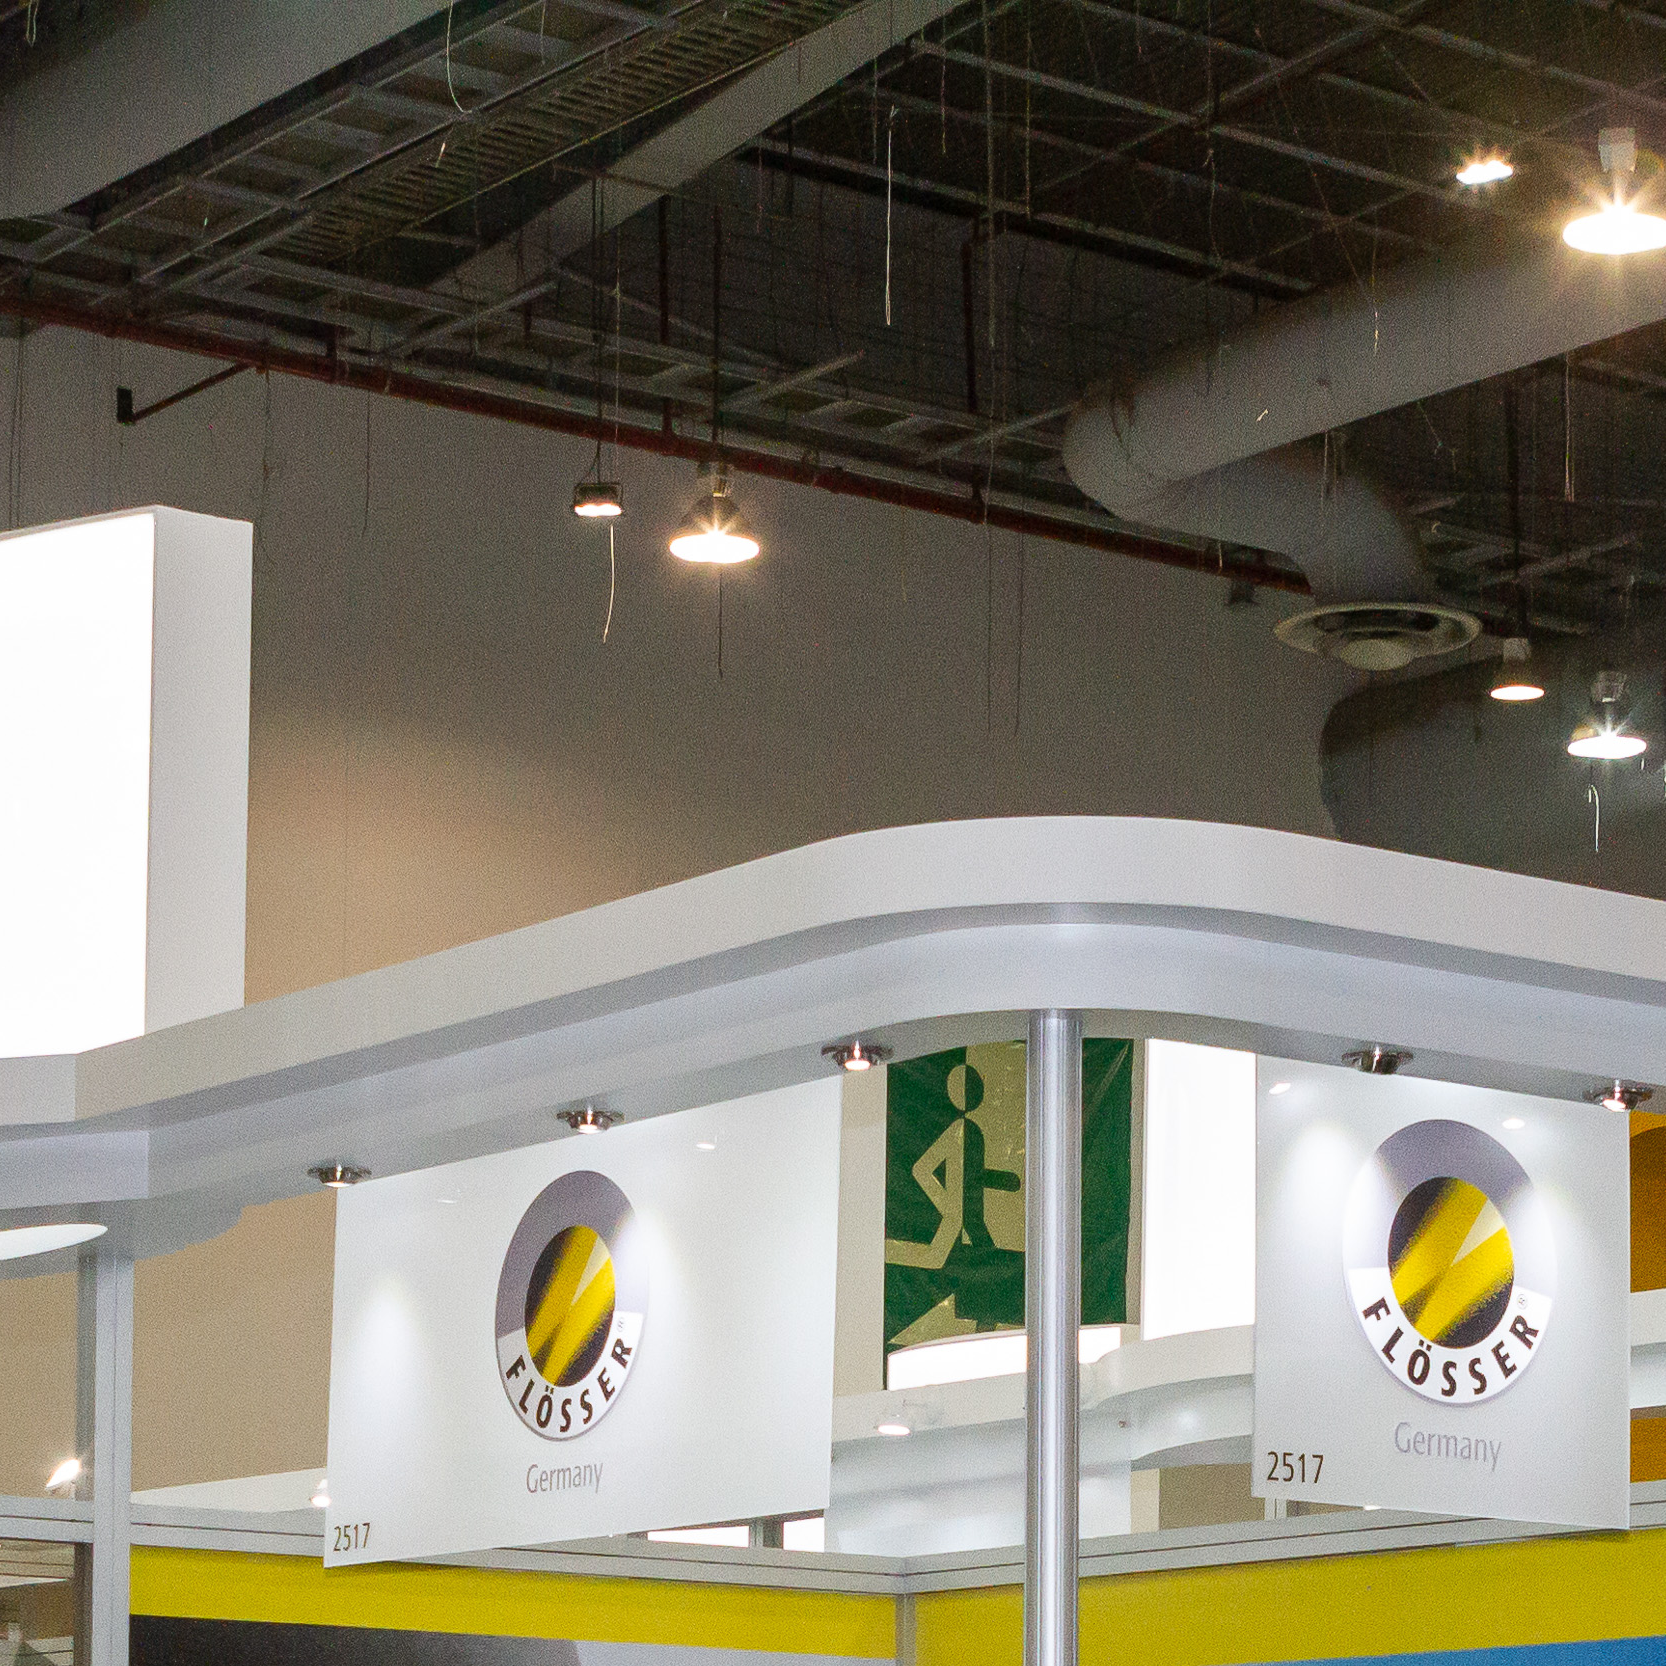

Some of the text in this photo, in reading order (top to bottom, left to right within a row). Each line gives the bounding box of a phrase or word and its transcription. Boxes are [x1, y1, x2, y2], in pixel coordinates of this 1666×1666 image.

[1362, 1296, 1540, 1398] FLÖSSER
[505, 1336, 634, 1432] FLÖSSER
[1266, 1450, 1325, 1485] 2517
[1393, 1420, 1502, 1473] Germany
[525, 1461, 604, 1495] Germany
[332, 1522, 371, 1552] 2517
